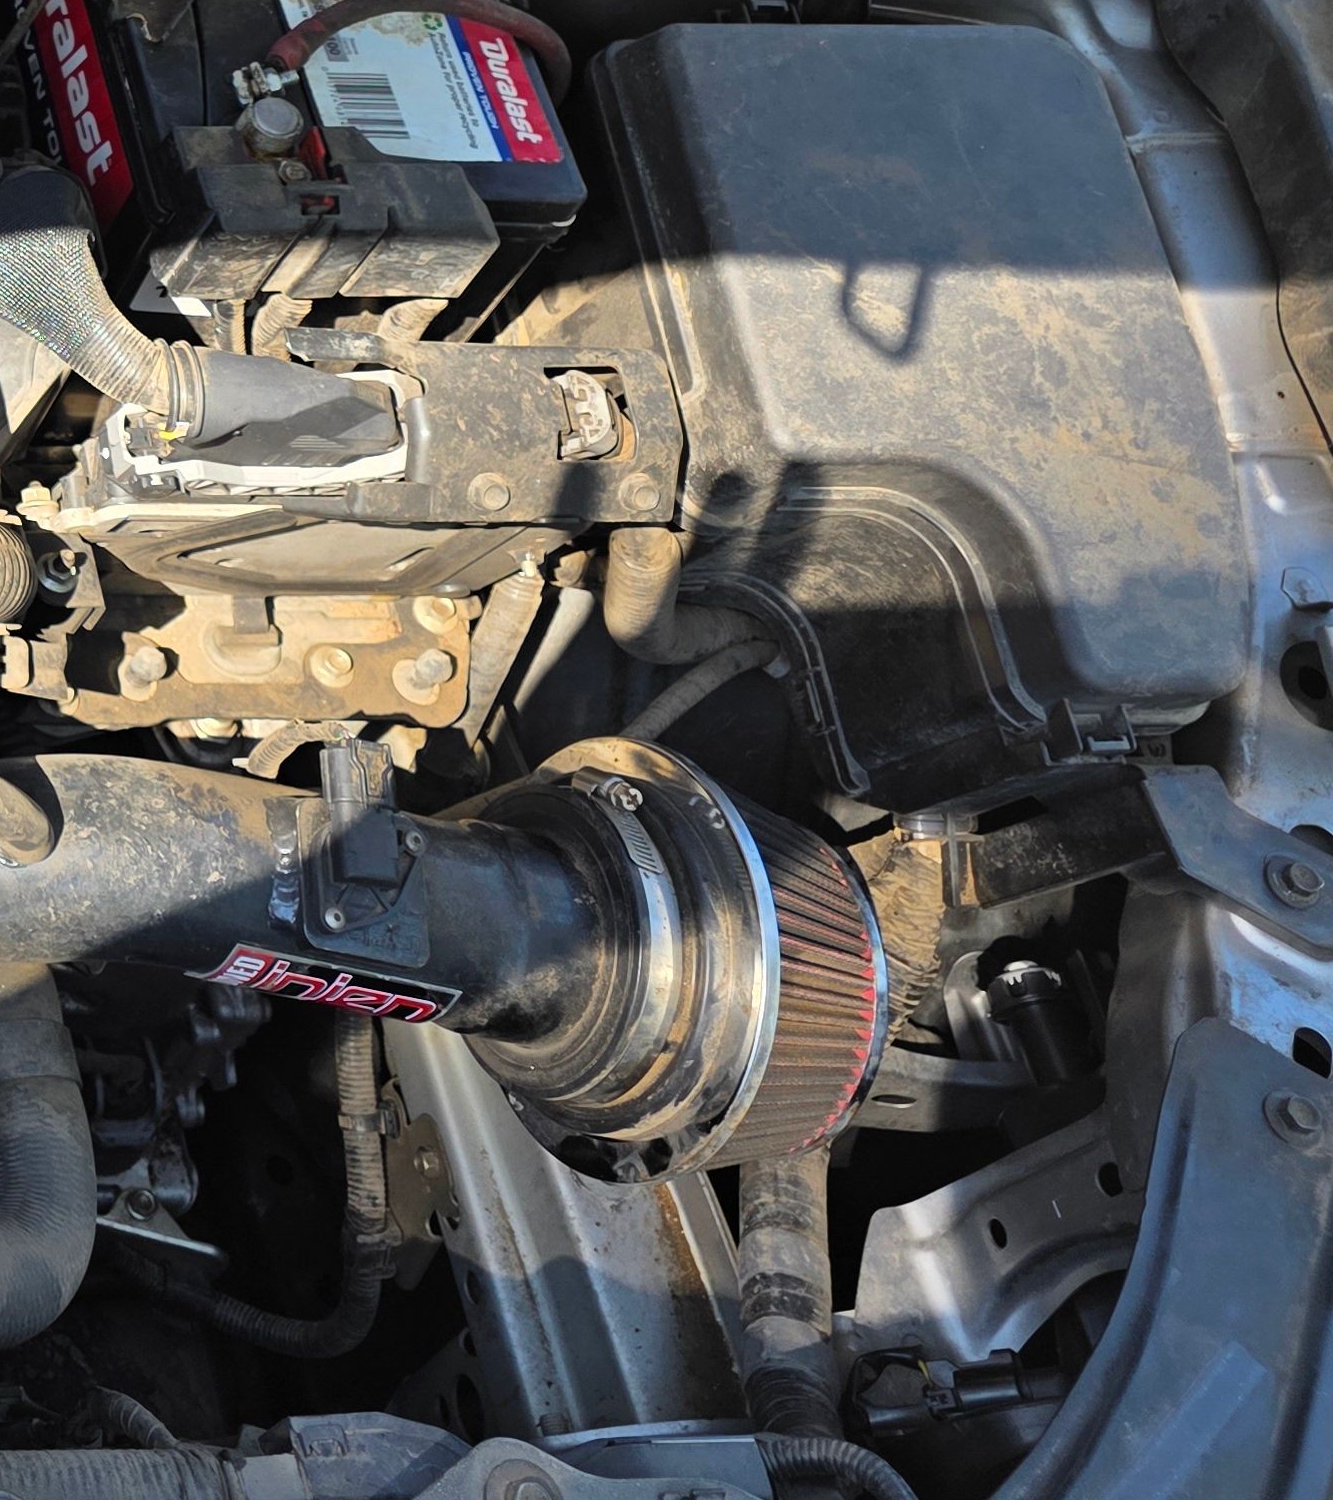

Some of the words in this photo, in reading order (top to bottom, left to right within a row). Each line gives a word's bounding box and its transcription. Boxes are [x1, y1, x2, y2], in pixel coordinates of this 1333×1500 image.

[443, 71, 453, 84] for
[445, 83, 464, 112] proper
[448, 60, 462, 80] used
[456, 81, 476, 117] batteries
[471, 118, 480, 128] to
[462, 51, 485, 93] PROVEN
[479, 94, 500, 129] TOUGH
[478, 37, 543, 144] Duralast
[458, 112, 479, 150] recycling
